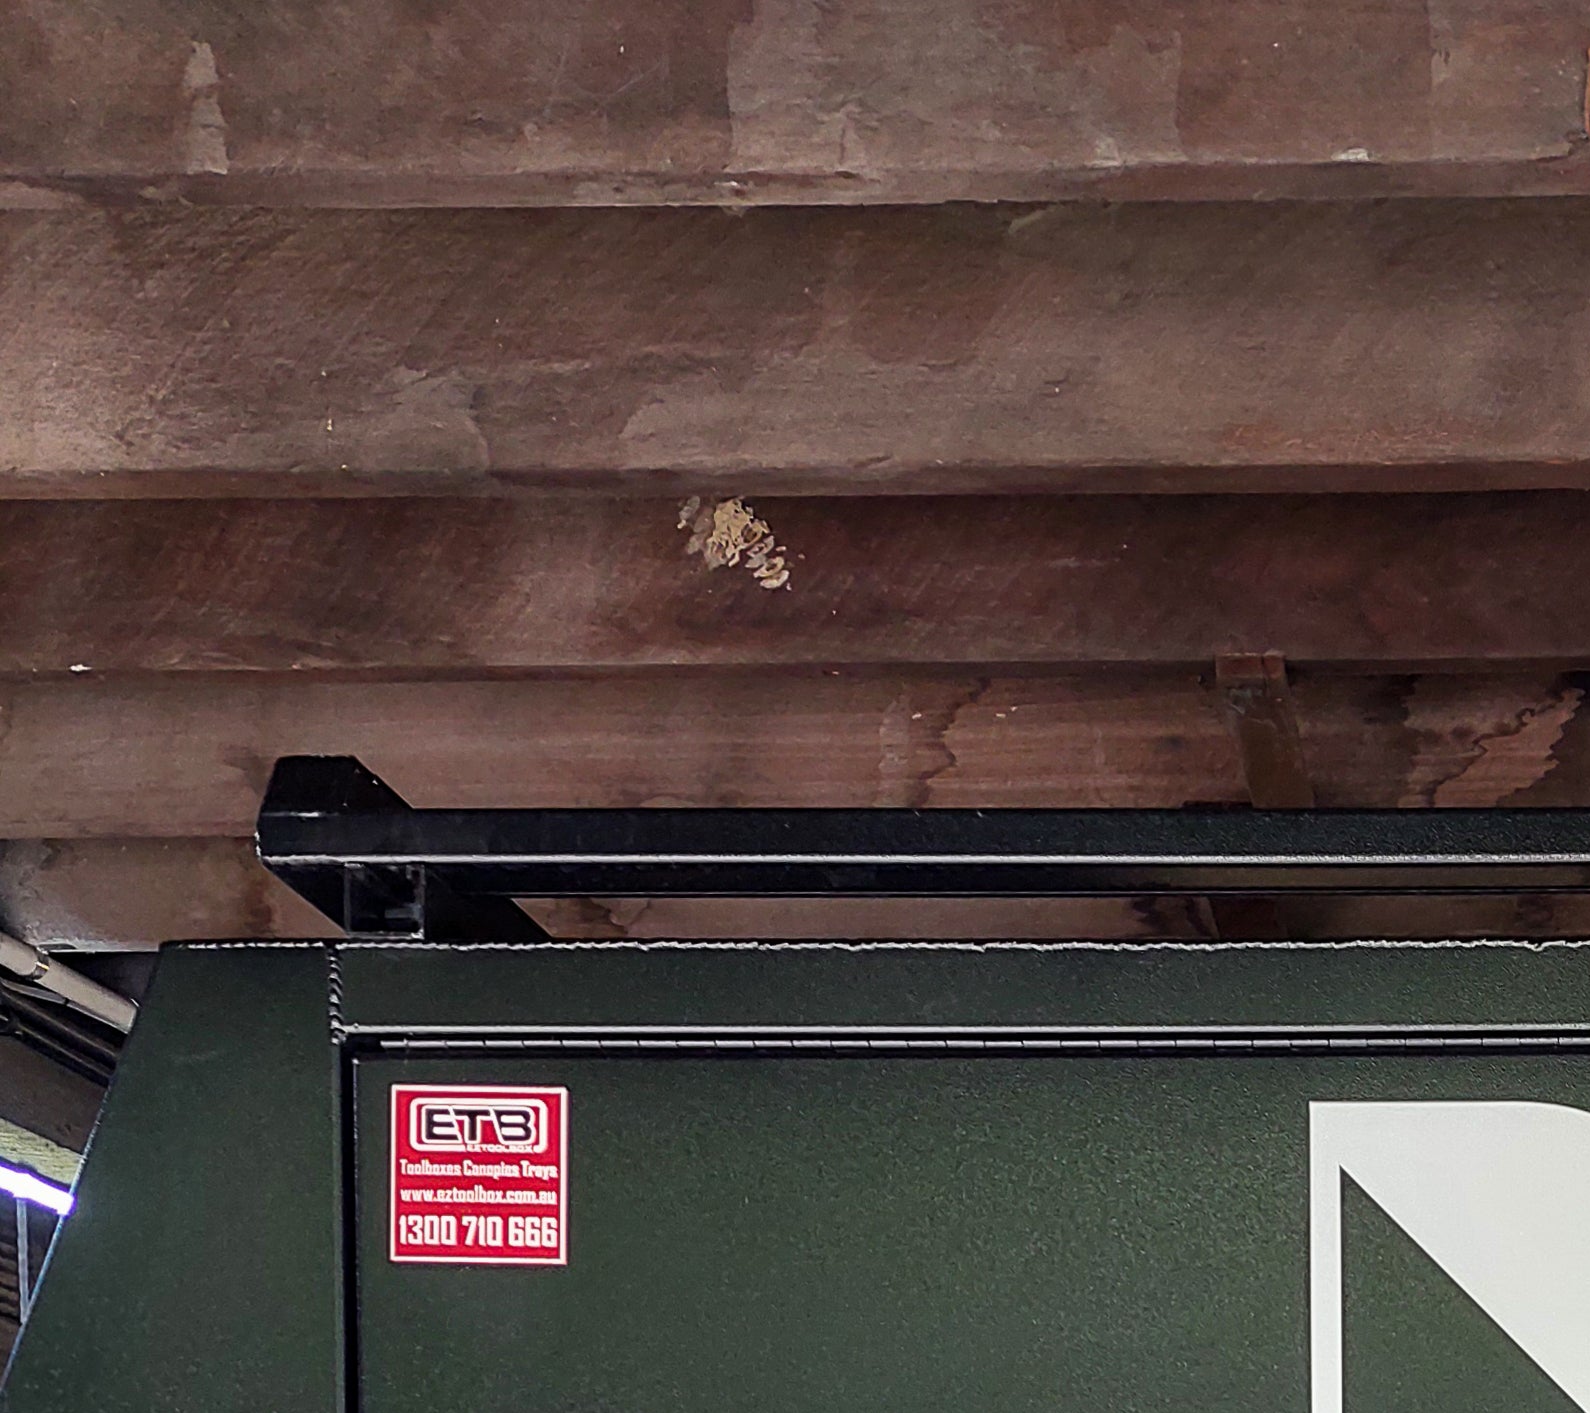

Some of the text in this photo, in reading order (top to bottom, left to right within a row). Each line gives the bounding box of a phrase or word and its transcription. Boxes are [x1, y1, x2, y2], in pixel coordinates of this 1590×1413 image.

[422, 1105, 536, 1144] ETB
[400, 1159, 462, 1176] Toolboxes
[520, 1160, 558, 1180] Trays
[400, 1185, 557, 1205] www.eztoolbox.com.au
[399, 1215, 558, 1248] 1300 710 666
